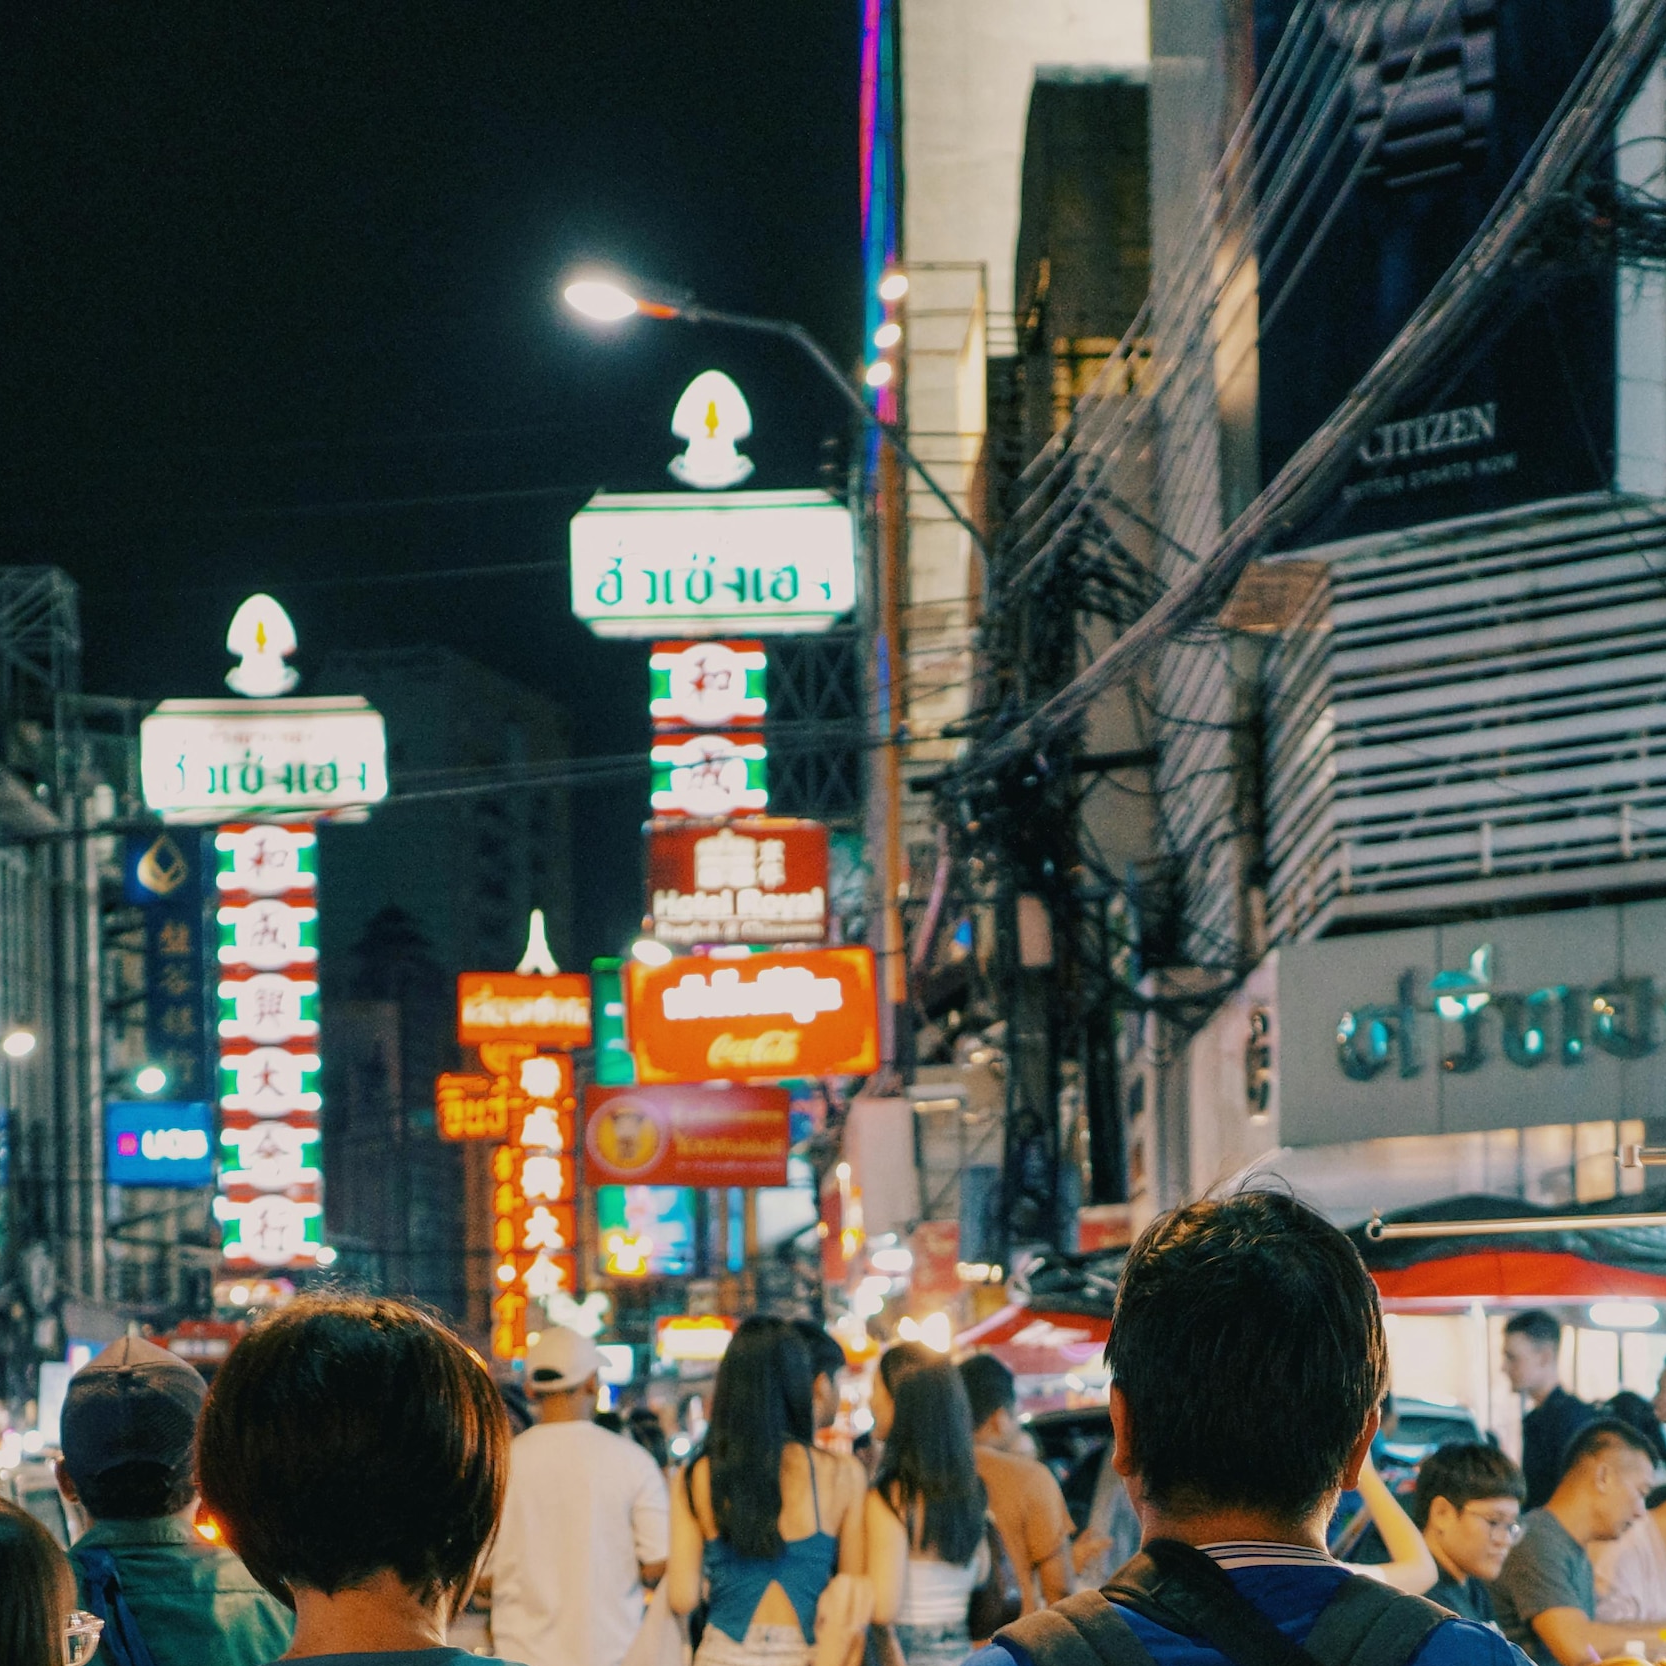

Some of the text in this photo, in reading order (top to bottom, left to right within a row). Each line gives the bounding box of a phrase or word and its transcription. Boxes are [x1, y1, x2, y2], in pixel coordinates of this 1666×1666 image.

[1357, 402, 1498, 464] CITIZEN
[653, 886, 826, 924] Hotel Royal
